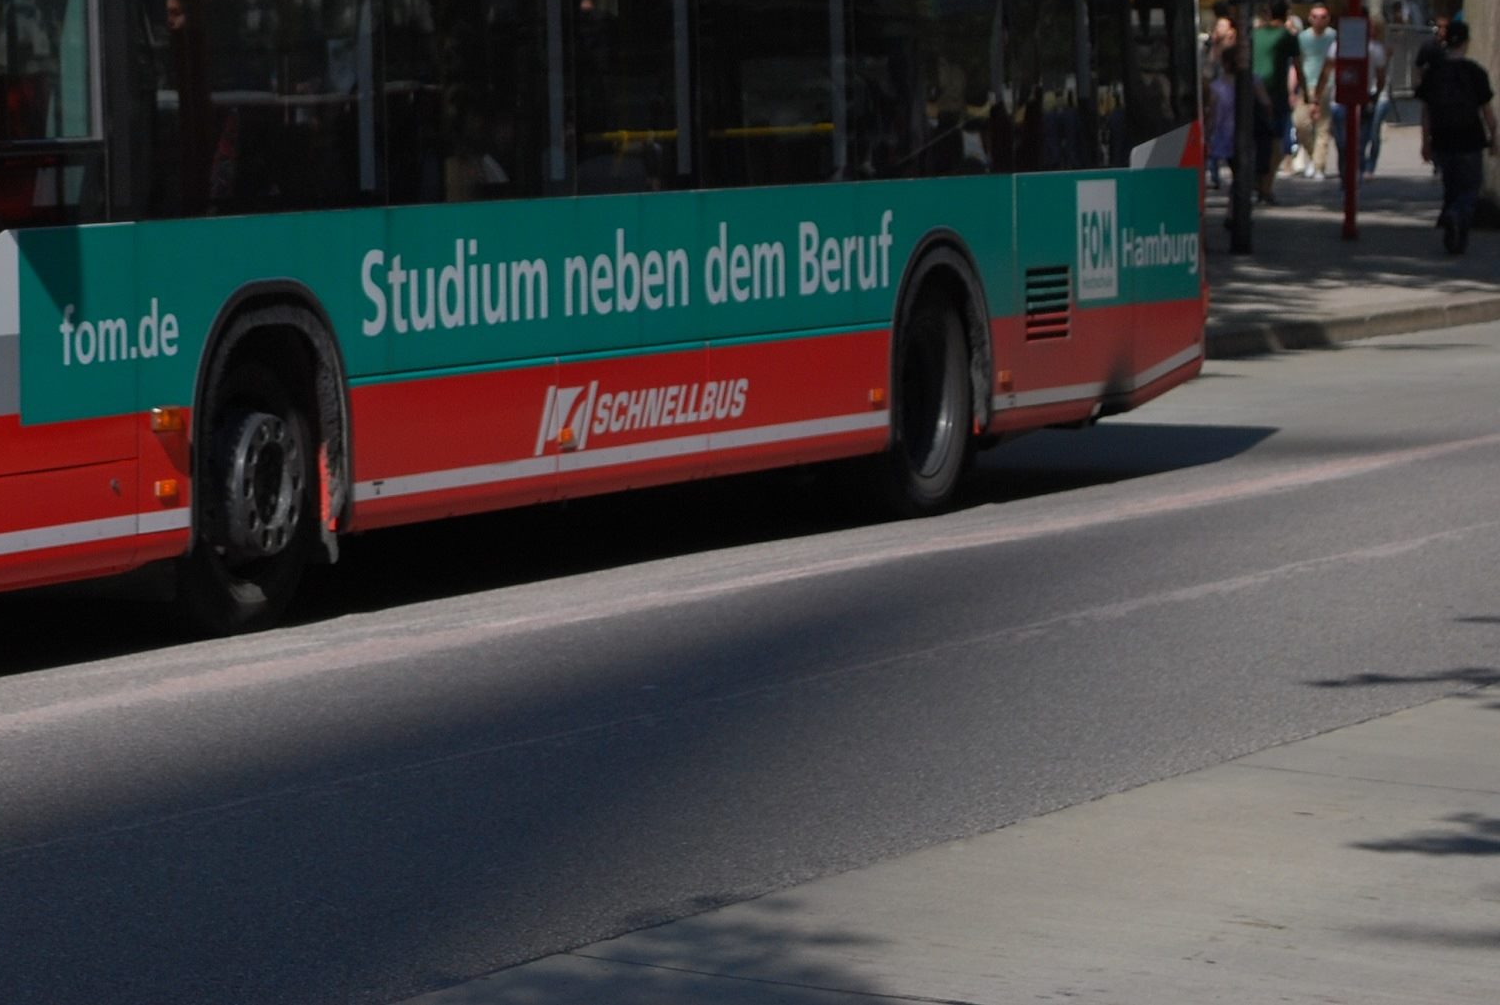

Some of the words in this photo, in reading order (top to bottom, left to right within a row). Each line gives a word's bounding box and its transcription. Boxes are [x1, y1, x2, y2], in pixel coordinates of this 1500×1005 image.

[1081, 210, 1113, 269] FOM
[1121, 221, 1200, 275] Hamburg
[361, 238, 548, 337] Studium
[563, 228, 690, 318] neben
[704, 221, 786, 305] dem
[799, 209, 893, 296] Beruf
[60, 298, 179, 366] fom.de
[592, 378, 749, 434] SCHNELLBUS
